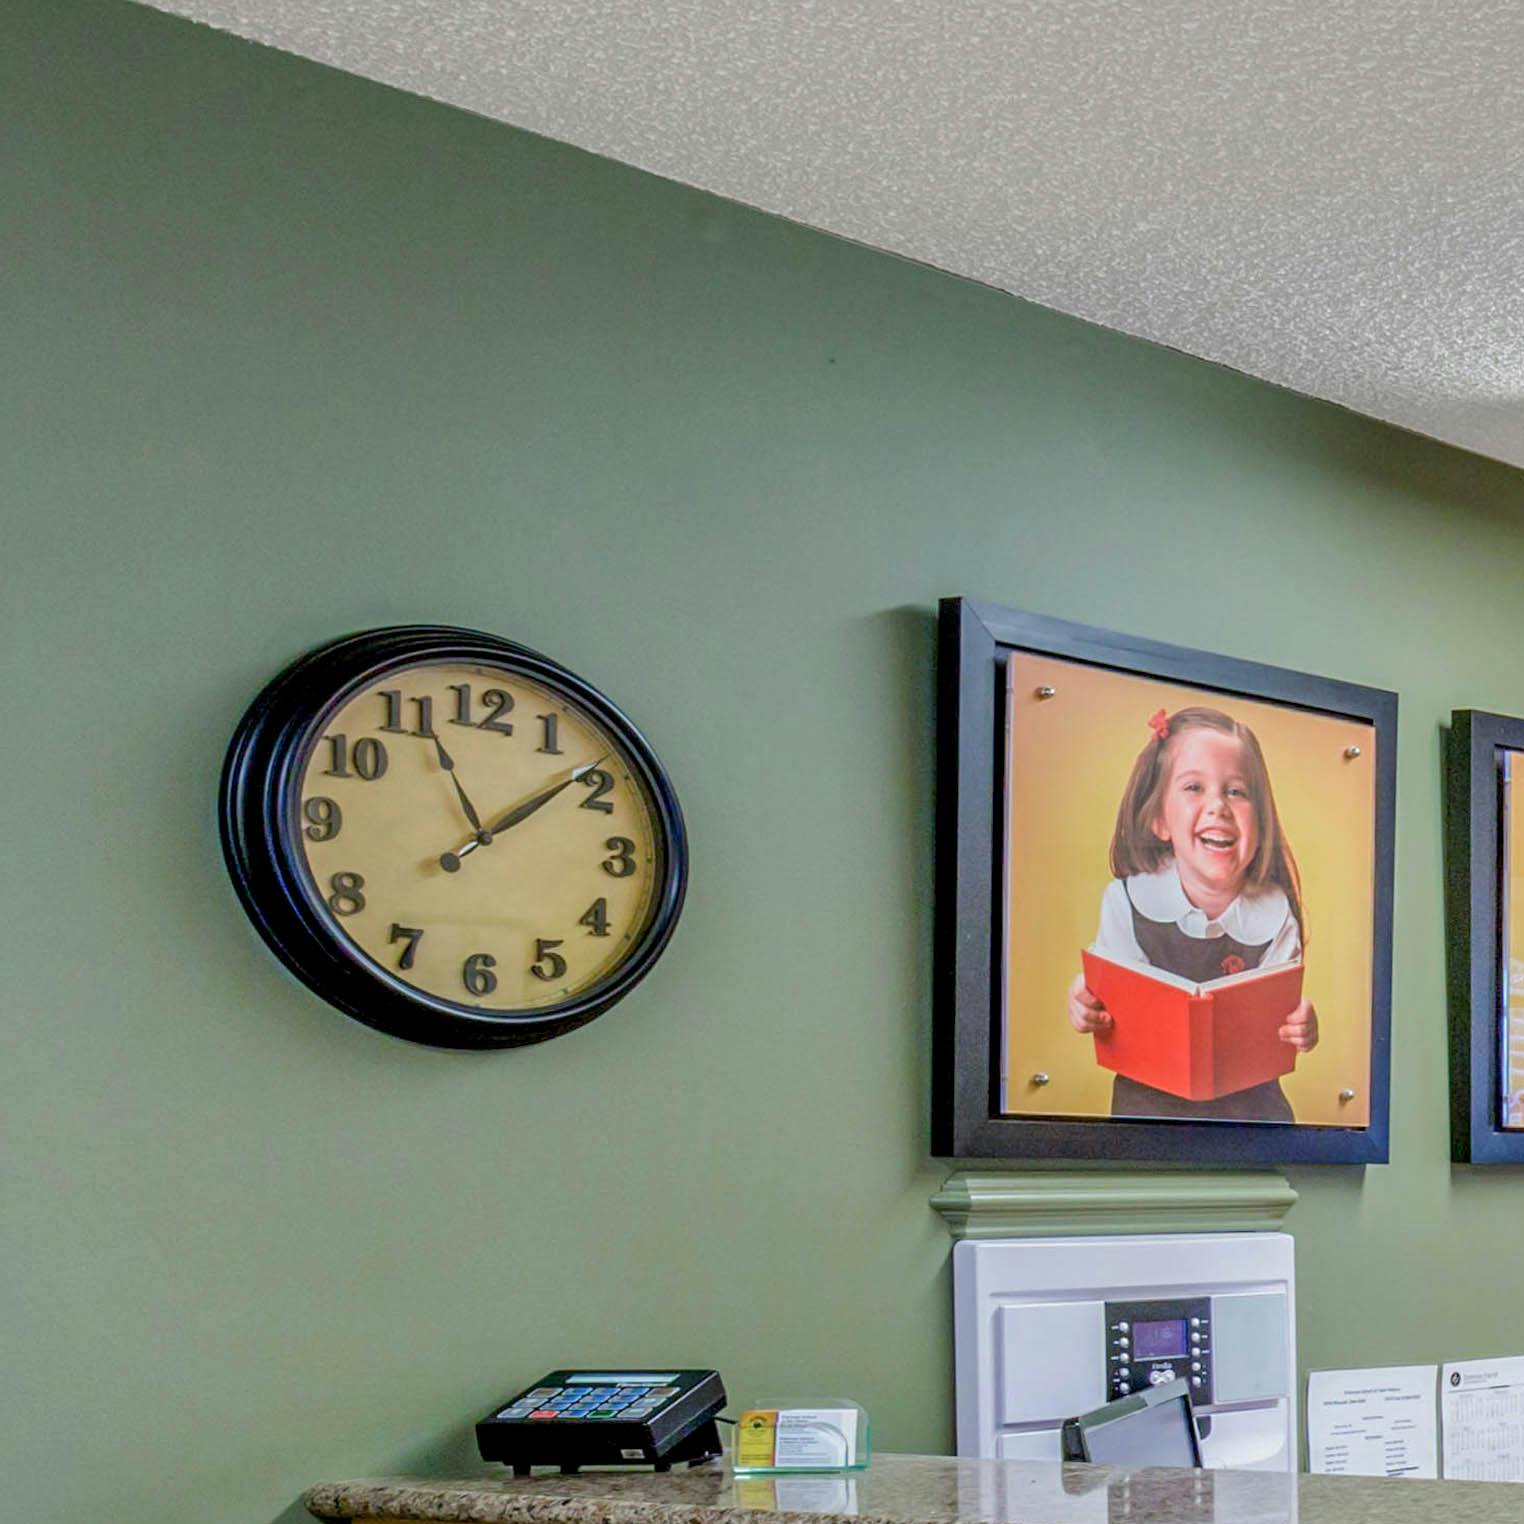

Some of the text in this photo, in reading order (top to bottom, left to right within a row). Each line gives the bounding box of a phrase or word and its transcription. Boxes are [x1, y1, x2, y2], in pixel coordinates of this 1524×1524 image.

[378, 690, 436, 738] 11
[448, 683, 514, 736] 12
[536, 711, 564, 756] 1
[323, 733, 389, 781] 10
[578, 766, 615, 815] 2
[304, 796, 343, 842] 9
[600, 836, 637, 879] 3
[328, 872, 366, 917] 8
[579, 897, 611, 937] 4
[389, 923, 424, 970] 7
[530, 938, 567, 982] 5
[463, 953, 498, 997] 6
